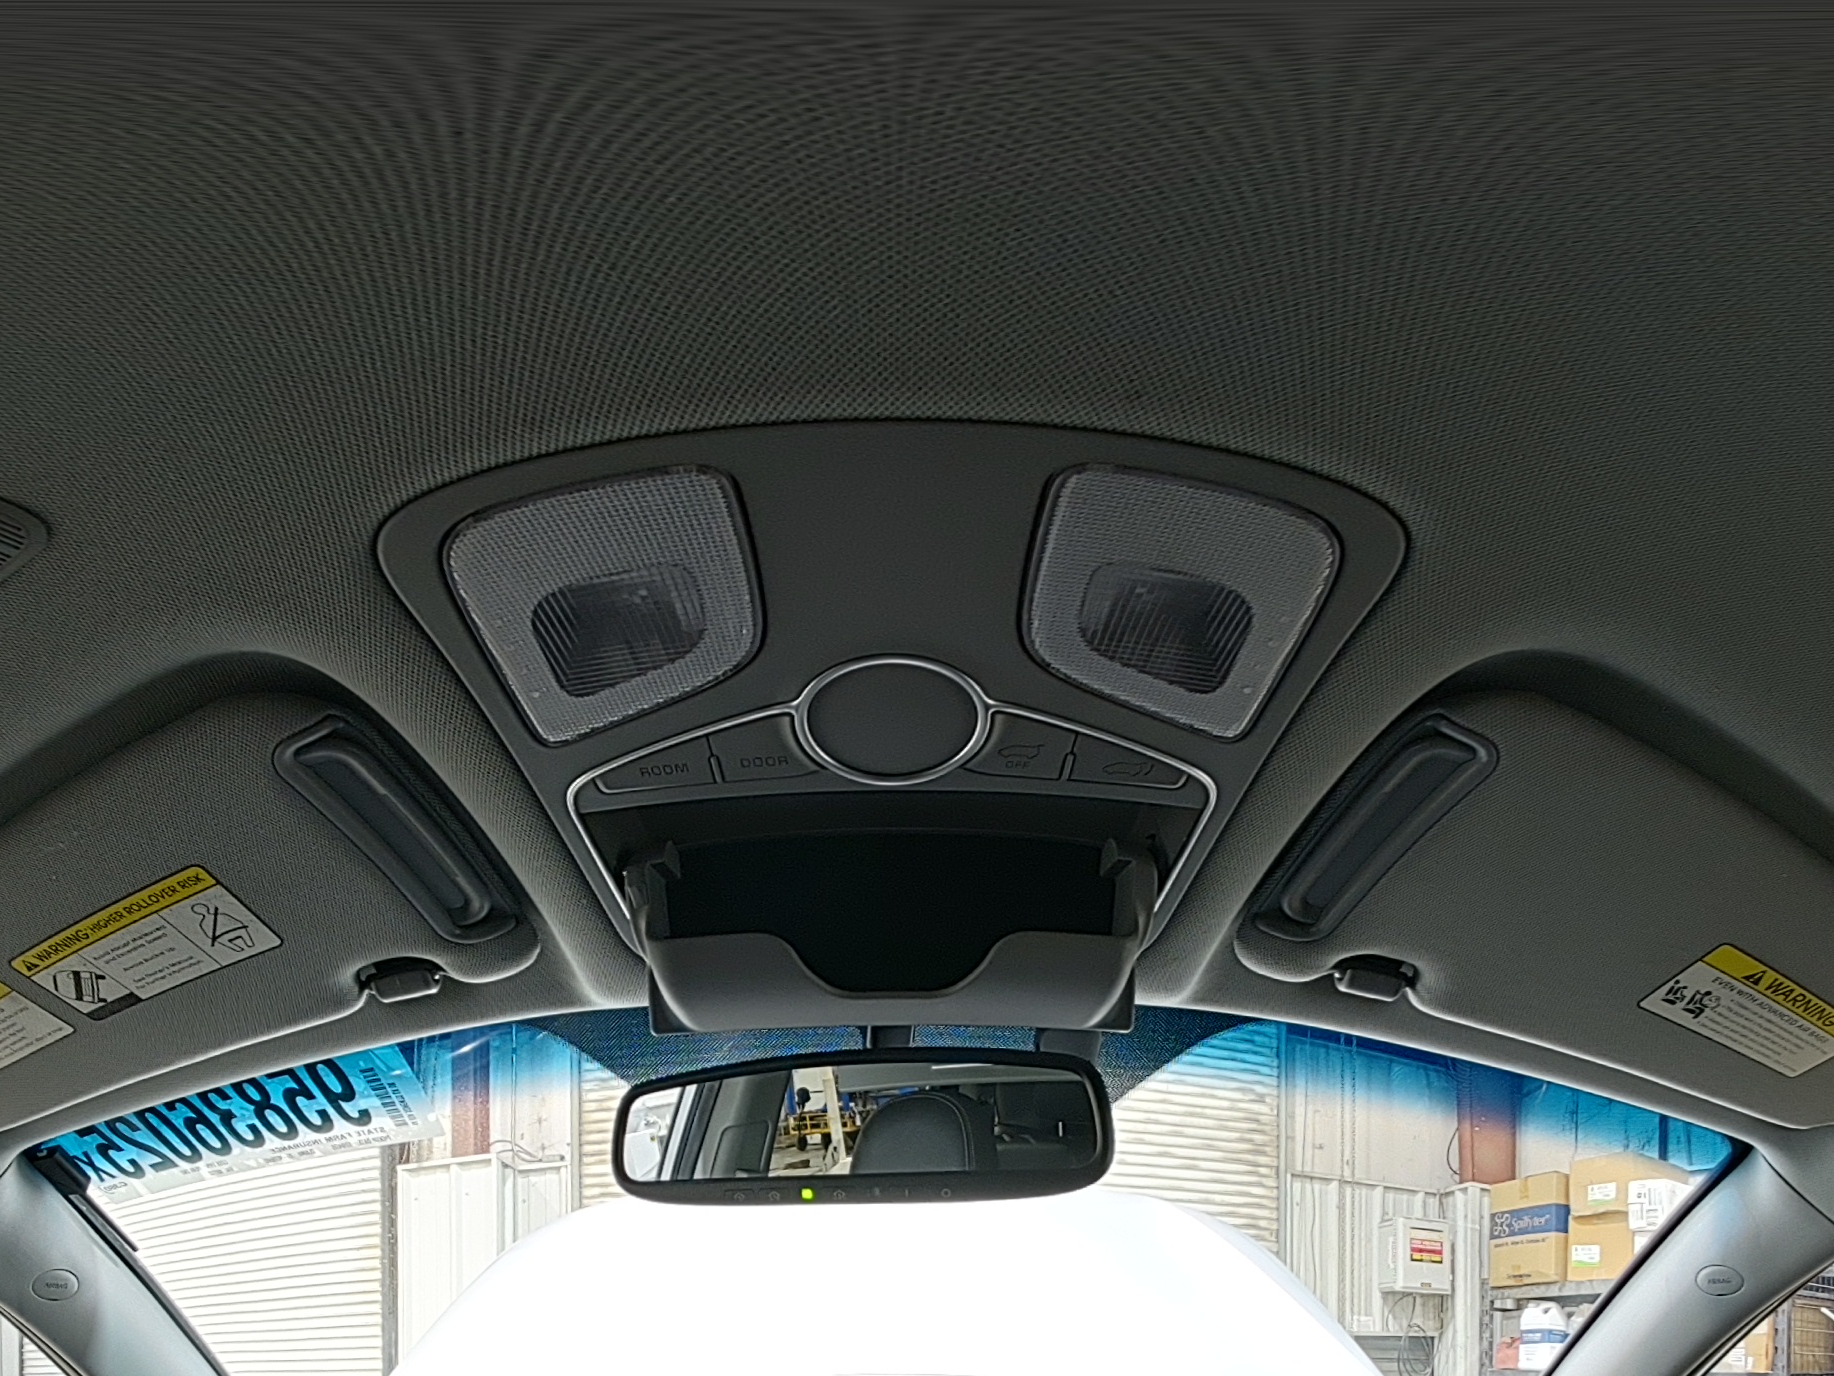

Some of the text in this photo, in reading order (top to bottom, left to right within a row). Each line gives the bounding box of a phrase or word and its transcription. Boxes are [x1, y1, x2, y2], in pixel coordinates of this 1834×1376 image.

[739, 755, 790, 769] DOOR
[1005, 760, 1032, 769] OFF
[639, 763, 690, 778] ROOM
[91, 911, 125, 936] HIGHER
[124, 886, 180, 917] ROLLOVER
[178, 873, 206, 892] RISK
[1711, 976, 1735, 994] EVEN
[1735, 986, 1758, 1003] WITH
